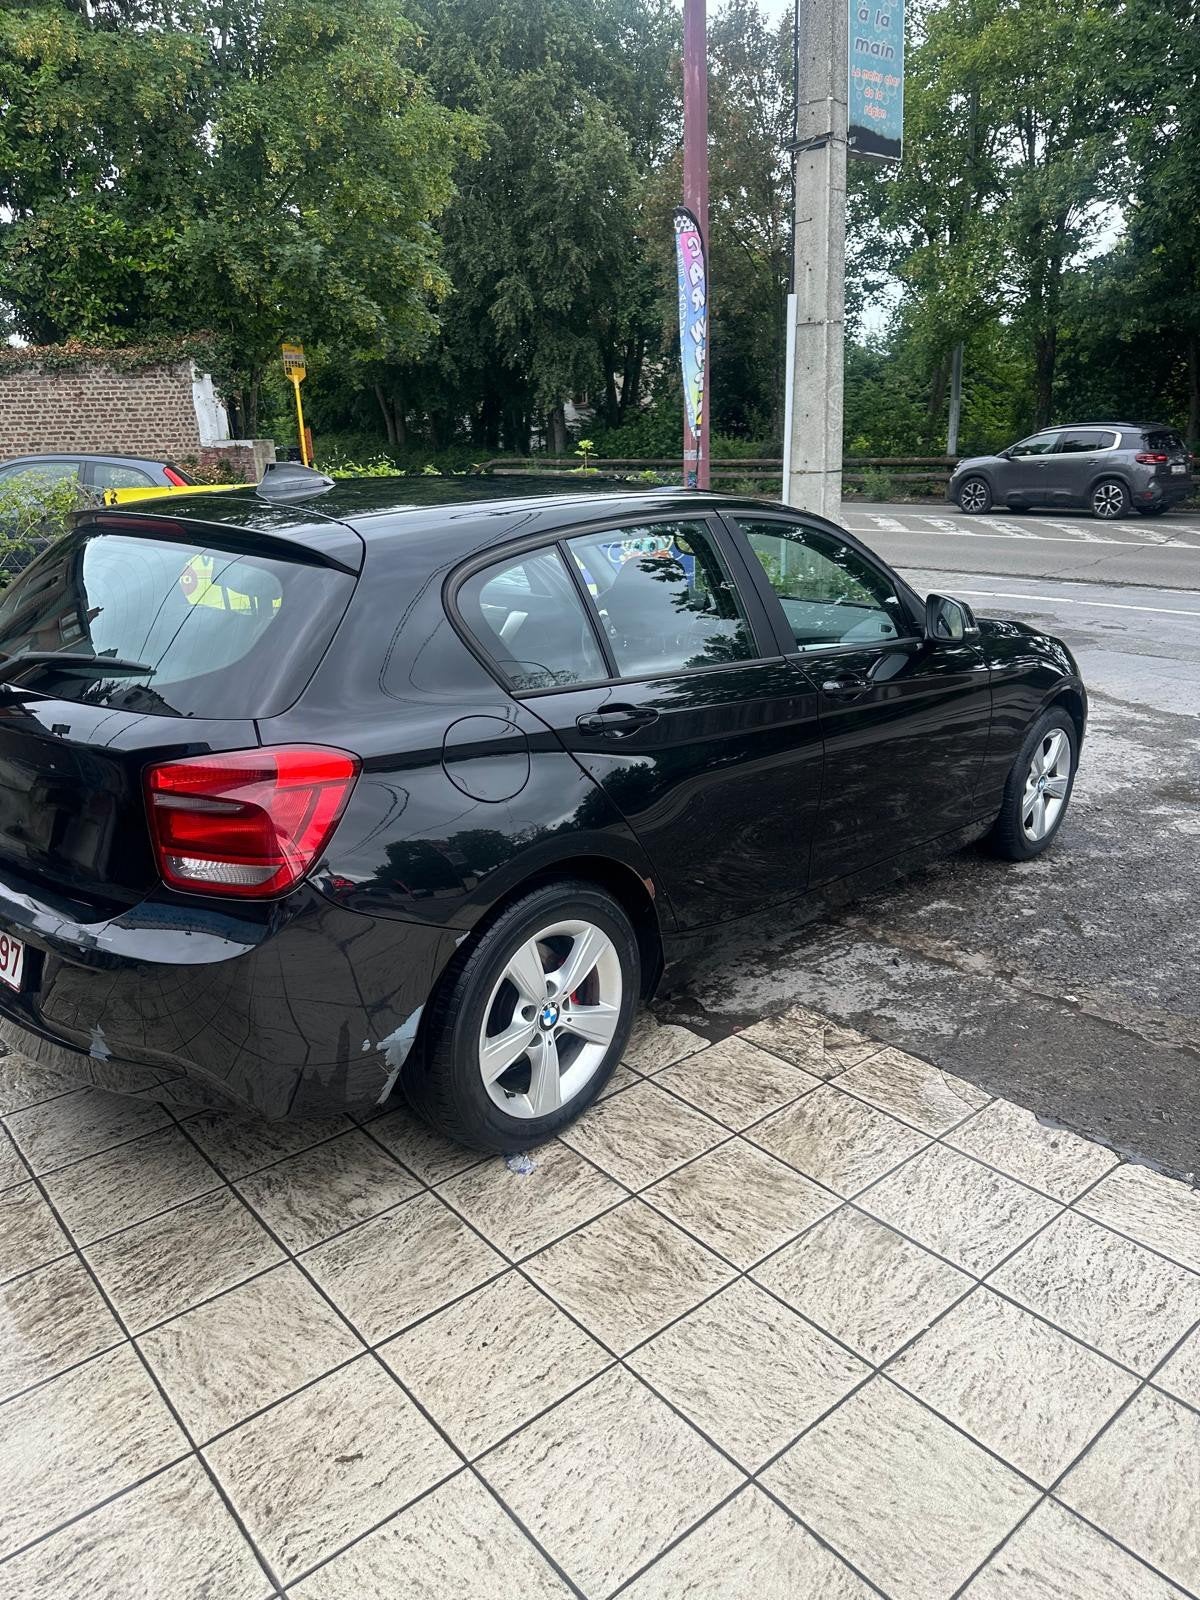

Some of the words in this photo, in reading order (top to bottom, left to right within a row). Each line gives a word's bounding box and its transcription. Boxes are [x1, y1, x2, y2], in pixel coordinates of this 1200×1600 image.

[875, 9, 891, 28] la
[855, 38, 895, 60] main
[0, 935, 21, 978] 97
